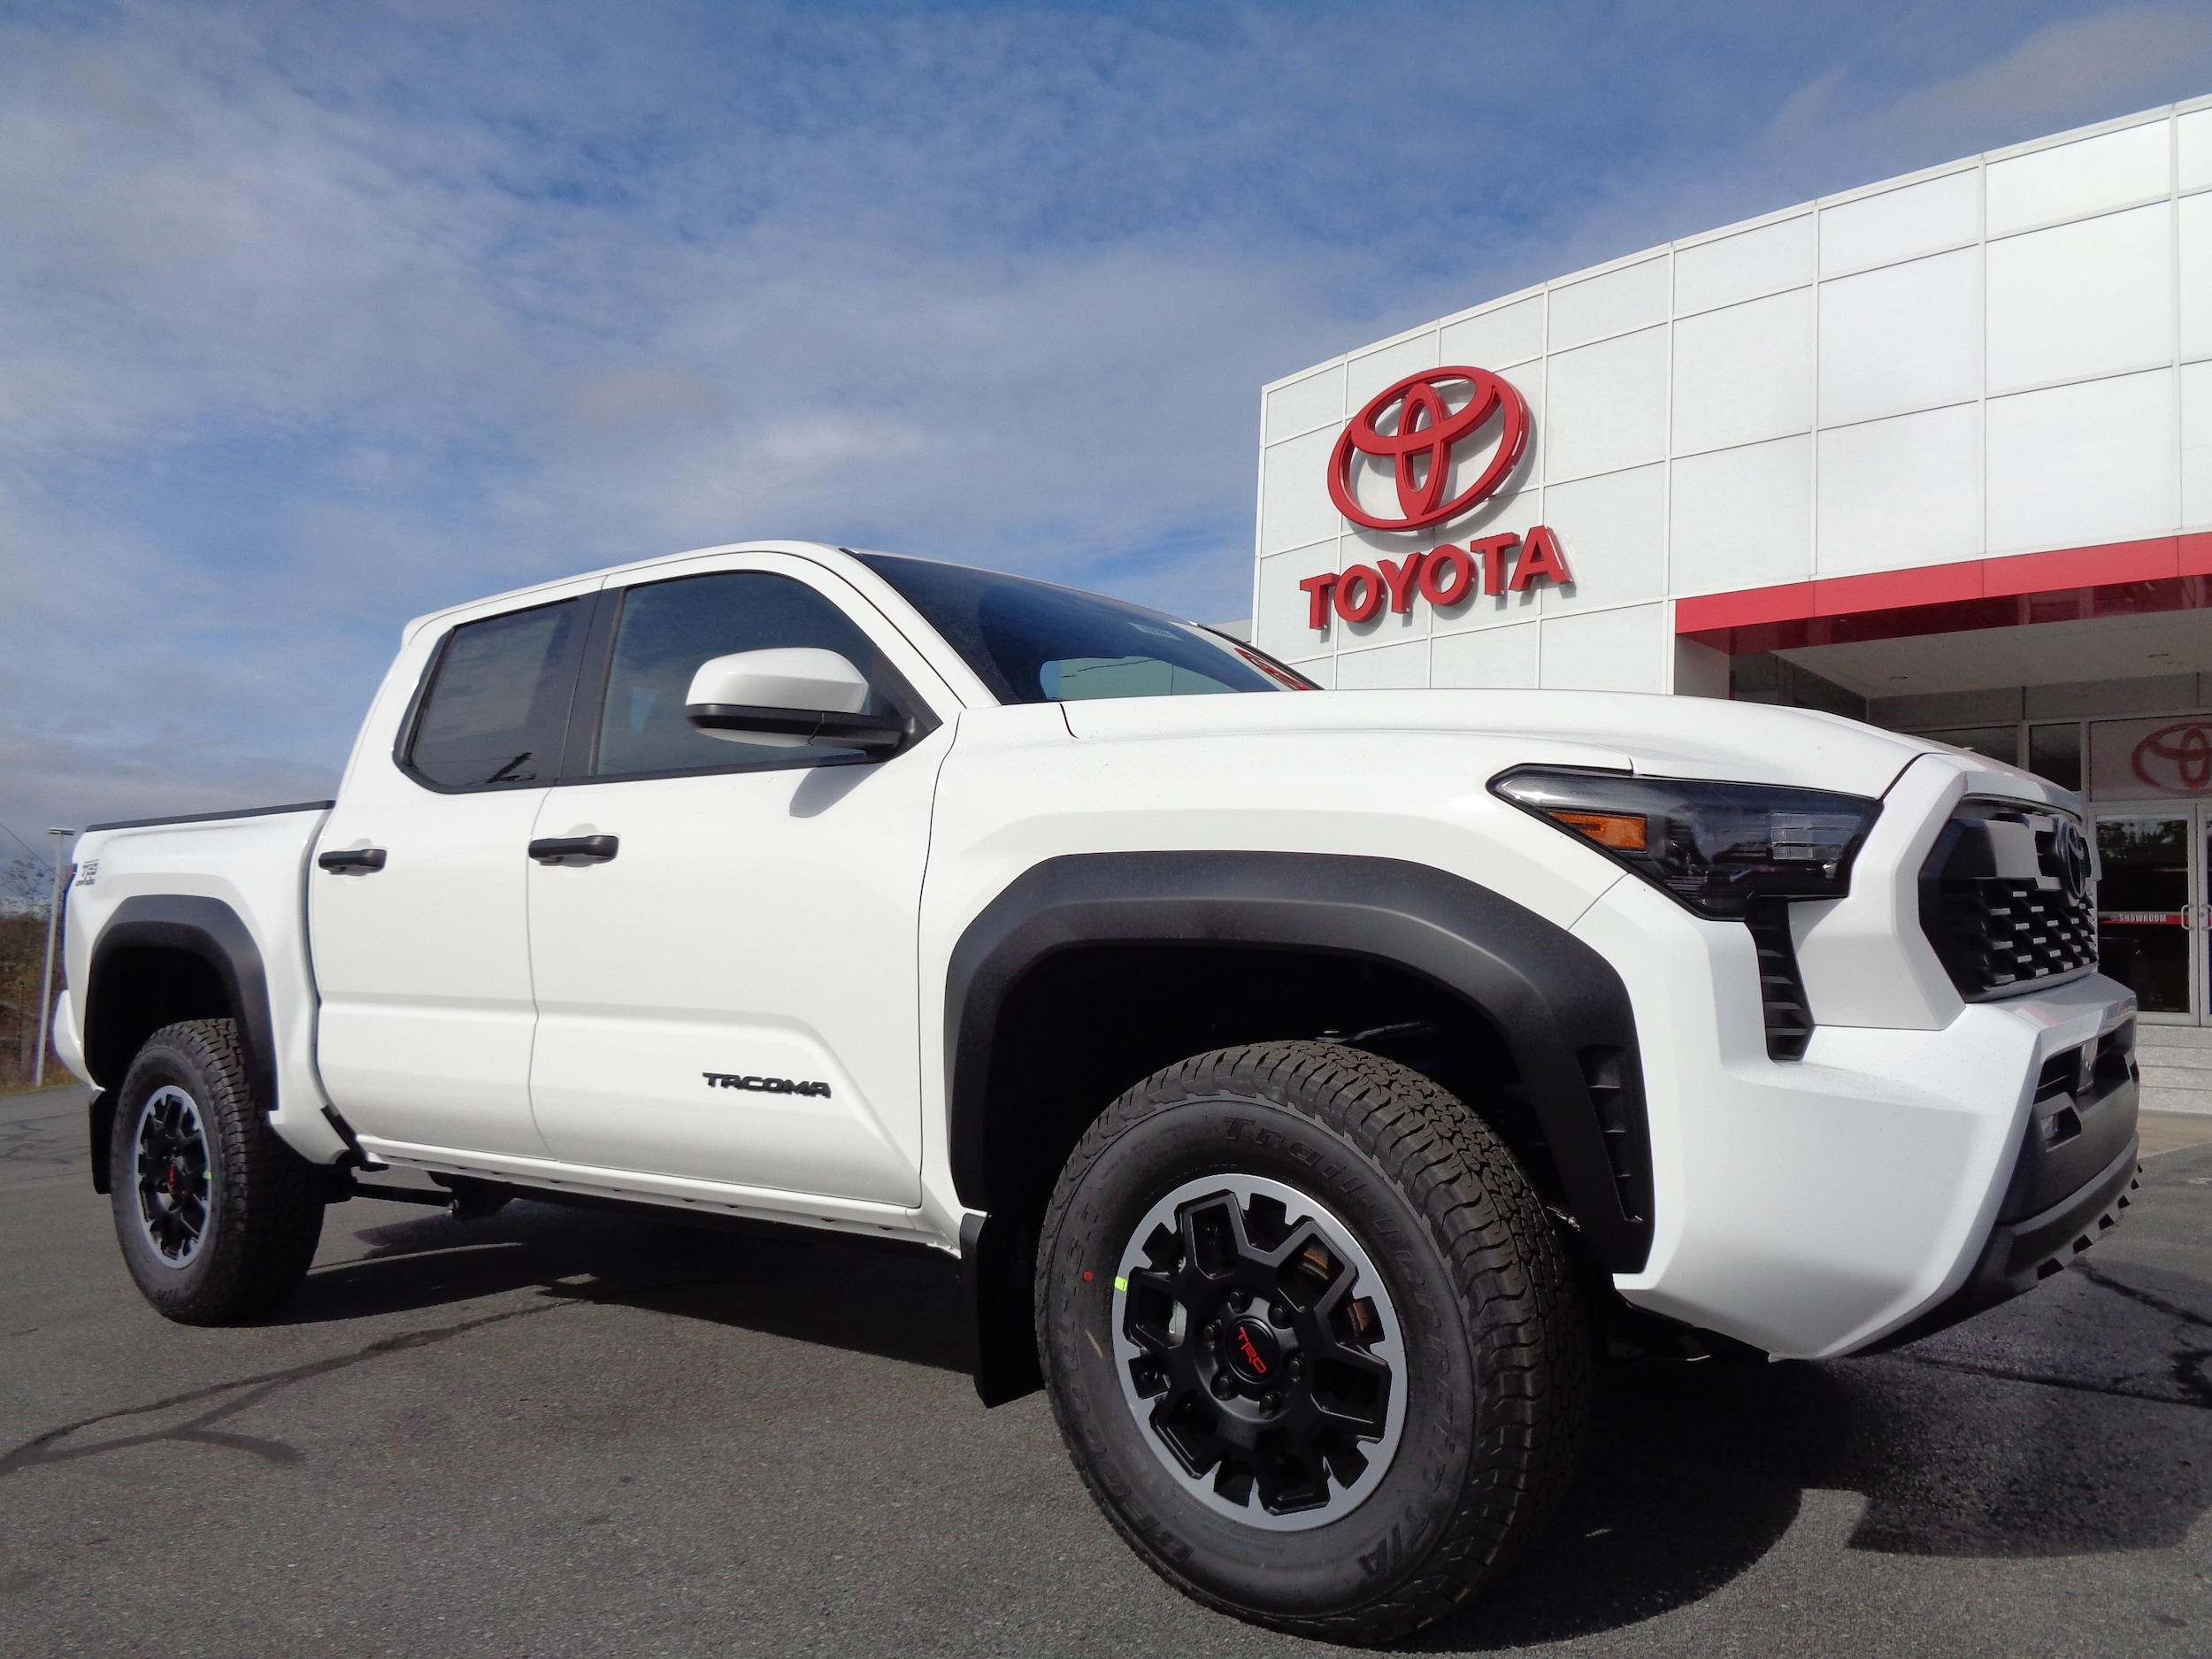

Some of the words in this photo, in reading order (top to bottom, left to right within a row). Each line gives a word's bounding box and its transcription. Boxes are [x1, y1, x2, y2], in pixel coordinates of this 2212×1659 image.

[1300, 525, 1572, 631] TOYOTA
[2118, 913, 2167, 923] SHOWROOM
[702, 1072, 831, 1099] TACOMA
[1238, 1325, 1267, 1374] TRD
